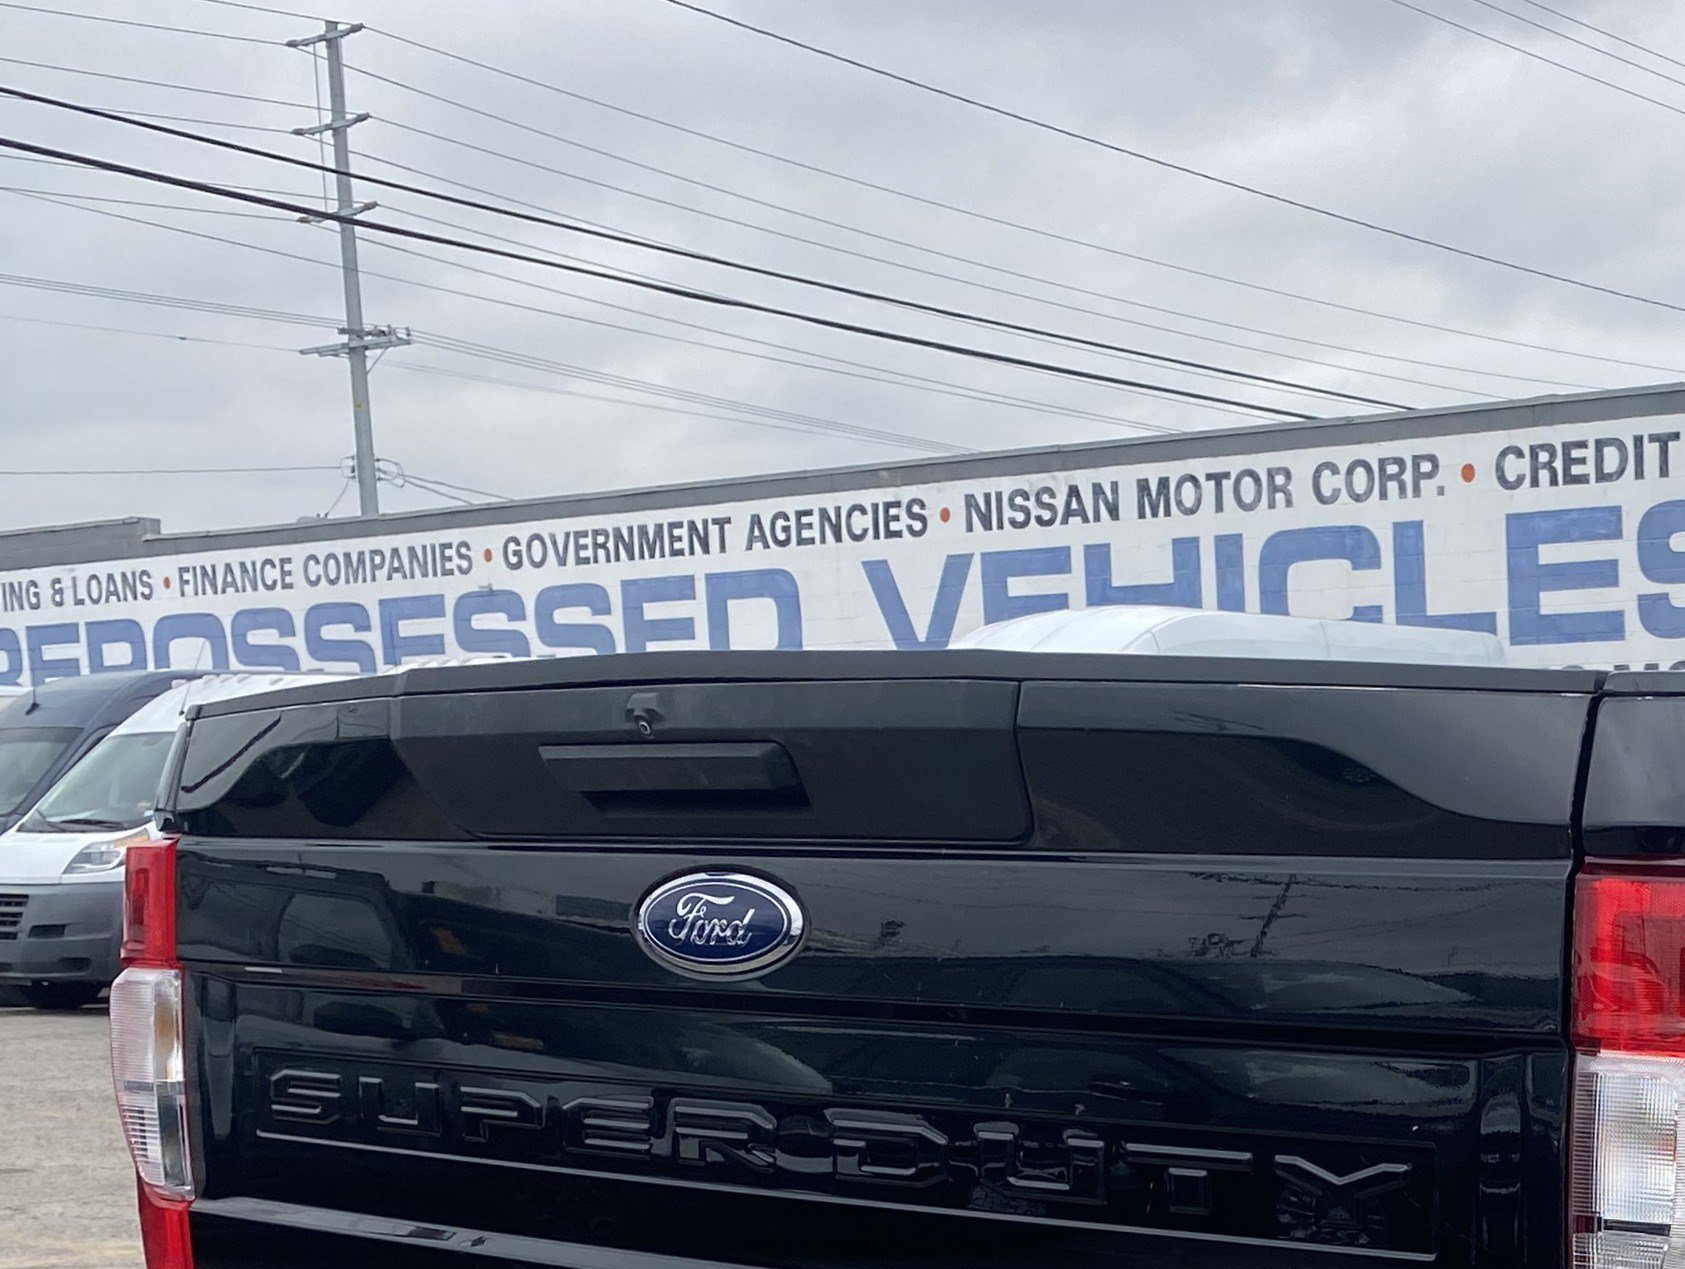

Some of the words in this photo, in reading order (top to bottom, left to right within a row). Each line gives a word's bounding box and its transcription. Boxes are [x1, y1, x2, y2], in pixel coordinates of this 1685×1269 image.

[50, 577, 64, 607] &
[71, 569, 154, 606] LOANS
[178, 557, 295, 598] FINANCE
[302, 541, 472, 588] COMPANIES
[502, 517, 732, 571] GOVERNMENT
[745, 498, 928, 551] AGENCIES
[964, 480, 1120, 532] NISSAN
[1136, 466, 1293, 519] MOTOR
[1311, 453, 1445, 506] CORP.
[1495, 432, 1681, 491] CREDIT
[668, 892, 755, 945] Ford
[268, 1066, 778, 1174] SUPER
[823, 1108, 1412, 1245] DUTY
